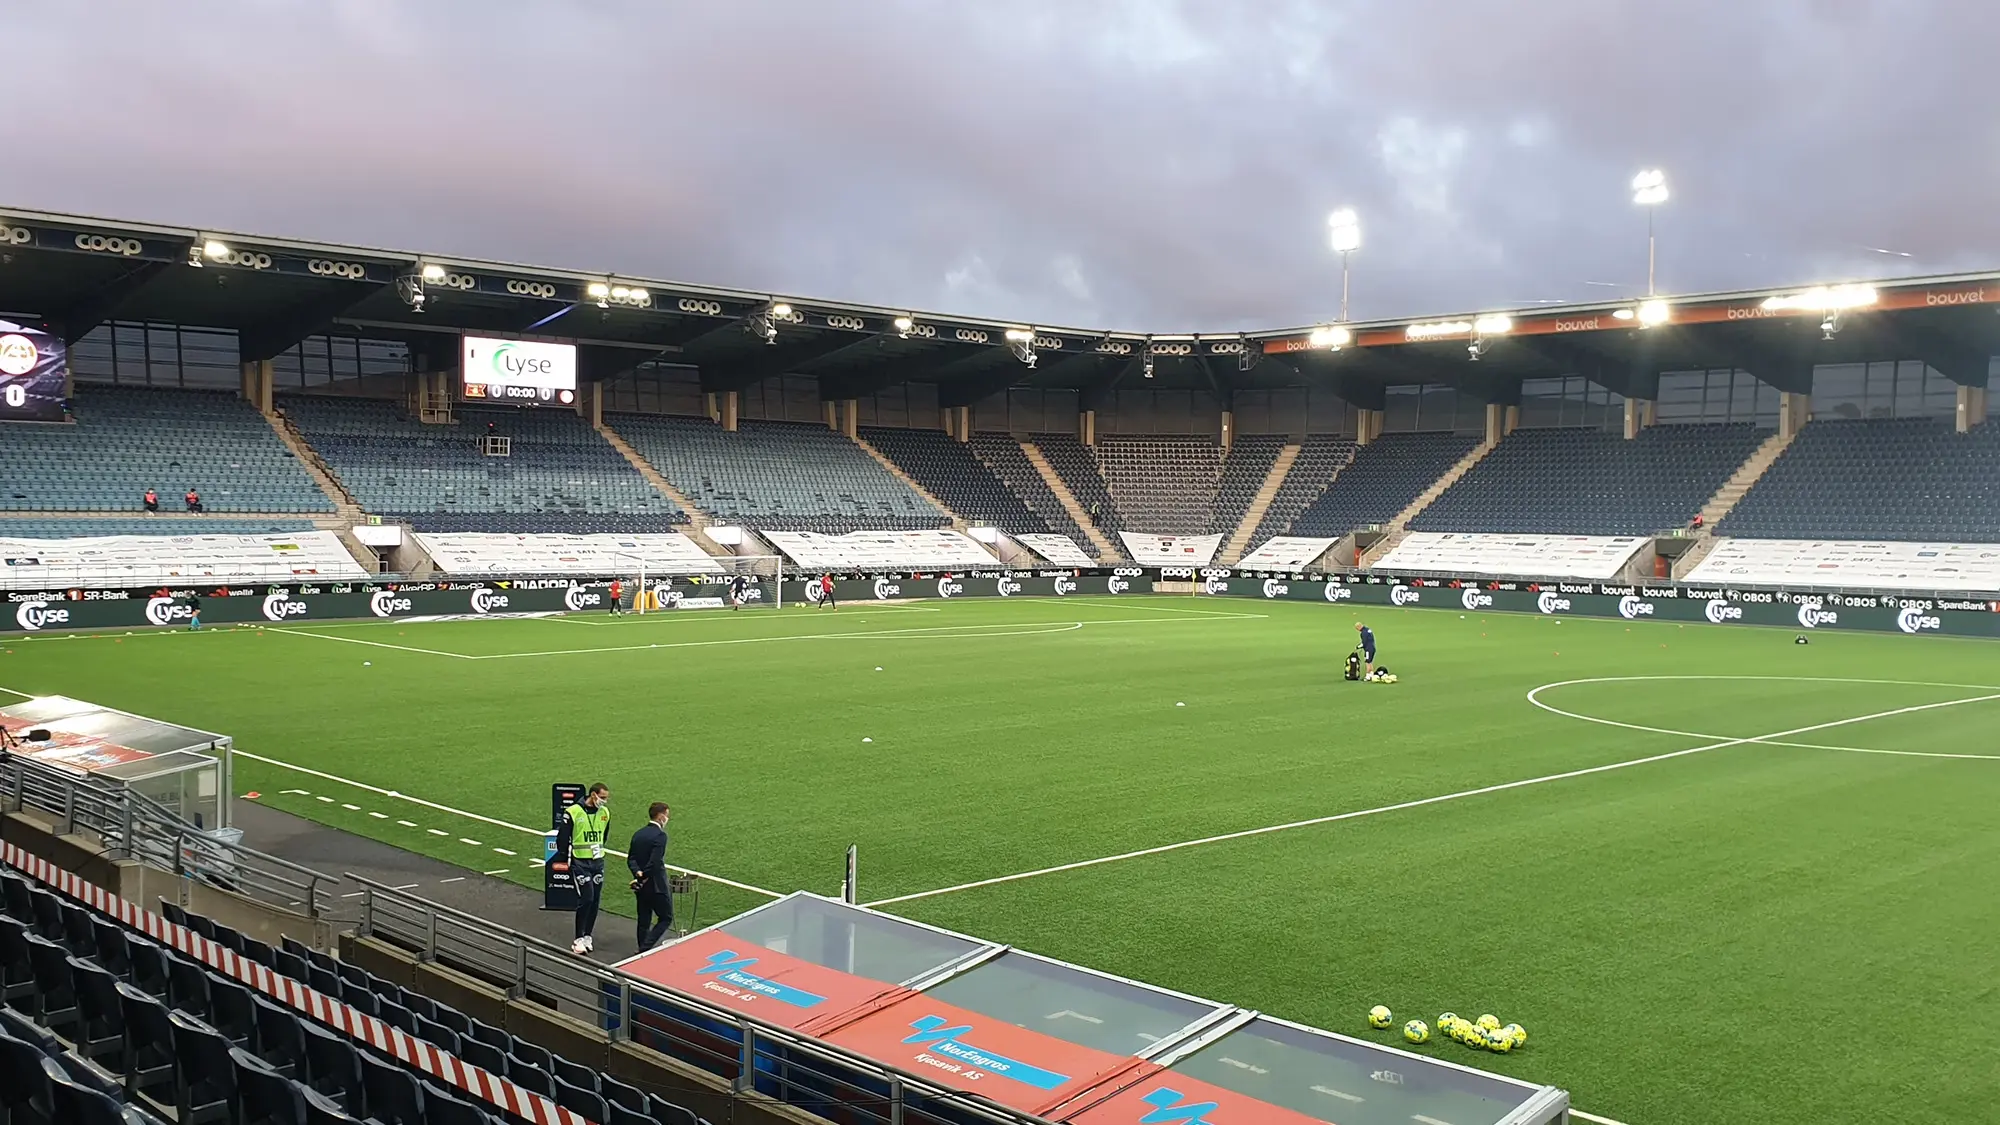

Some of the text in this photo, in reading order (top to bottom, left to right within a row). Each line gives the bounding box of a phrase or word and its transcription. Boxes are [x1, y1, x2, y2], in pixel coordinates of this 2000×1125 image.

[75, 234, 142, 256] coop
[308, 259, 365, 279] coop
[507, 280, 556, 298] coop
[1927, 288, 1984, 305] bouvet
[679, 298, 721, 315] coop
[827, 315, 864, 330] coop
[1555, 316, 1599, 331] bouvet
[903, 322, 936, 338] oop
[956, 329, 988, 343] coop
[1151, 343, 1191, 355] coop
[506, 355, 551, 376] Lyse
[6, 384, 25, 407] 0
[492, 385, 551, 400] 0 00:00 0
[1114, 568, 1143, 577] coop
[1161, 567, 1191, 578] coop
[1200, 568, 1231, 578] coop
[513, 579, 579, 589] DIADORA
[880, 584, 900, 597] Lyse
[944, 583, 963, 594] Lyse
[1003, 581, 1021, 593] Lyse
[1060, 580, 1077, 591] Lyse
[1113, 580, 1129, 592] Lyse
[1209, 580, 1228, 593] Lyse
[1269, 583, 1288, 596] Lyse
[1560, 583, 1593, 594] bouvet
[1601, 584, 1635, 596] bouvet
[8, 592, 66, 602] SpareBank
[84, 590, 129, 600] SR-Bank
[660, 591, 684, 604] Lyse
[1331, 587, 1351, 599] Lyse
[1398, 590, 1420, 603] Lyse
[1642, 586, 1678, 598] bouvet
[1687, 588, 1723, 600] bouvet
[1743, 592, 1772, 603] OBOS
[381, 597, 412, 613] Lyse
[480, 594, 509, 610] Lyse
[573, 592, 600, 608] Lyse
[1469, 593, 1492, 607] Lyse
[1546, 597, 1570, 611] Lyse
[1793, 594, 1823, 605] OBOS
[1845, 597, 1876, 608] OBOS
[1900, 599, 1933, 610] OBOS
[1938, 600, 1986, 612] SpareBank
[273, 601, 307, 618] Lyse
[1627, 601, 1654, 615] Lyse
[1714, 605, 1742, 619] Lyse
[29, 607, 69, 626] Lyse
[1807, 609, 1837, 624] Lyse
[1908, 613, 1940, 630] Lyse
[583, 830, 602, 842] VERT
[553, 873, 570, 881] coop
[737, 993, 757, 1002] AS
[939, 1043, 1010, 1071] NorEngros
[914, 1053, 984, 1080] Kjosavik AS
